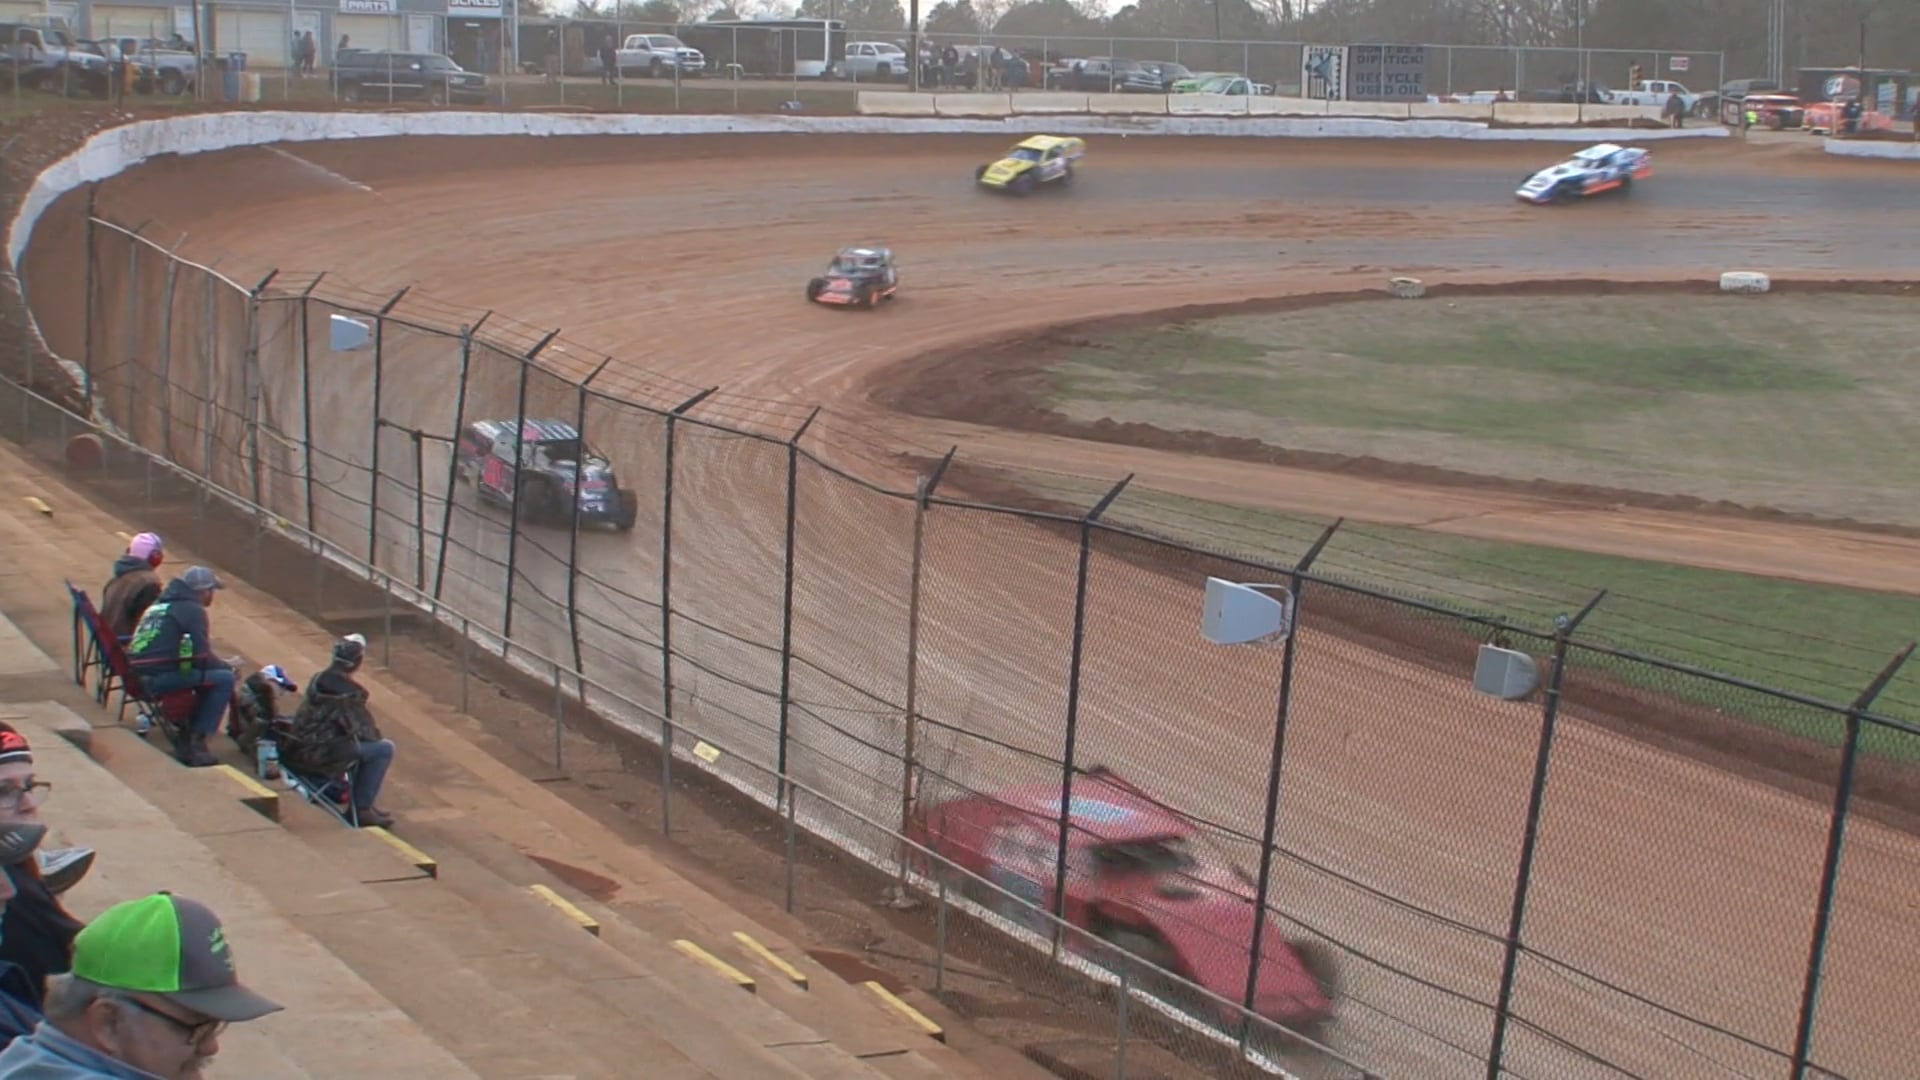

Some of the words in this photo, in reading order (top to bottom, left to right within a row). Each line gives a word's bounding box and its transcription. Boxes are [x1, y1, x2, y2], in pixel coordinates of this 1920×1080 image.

[347, 1, 389, 10] PARTS
[1355, 73, 1423, 84] RECYCLE
[1355, 84, 1393, 96] USED
[1398, 85, 1422, 96] OIL
